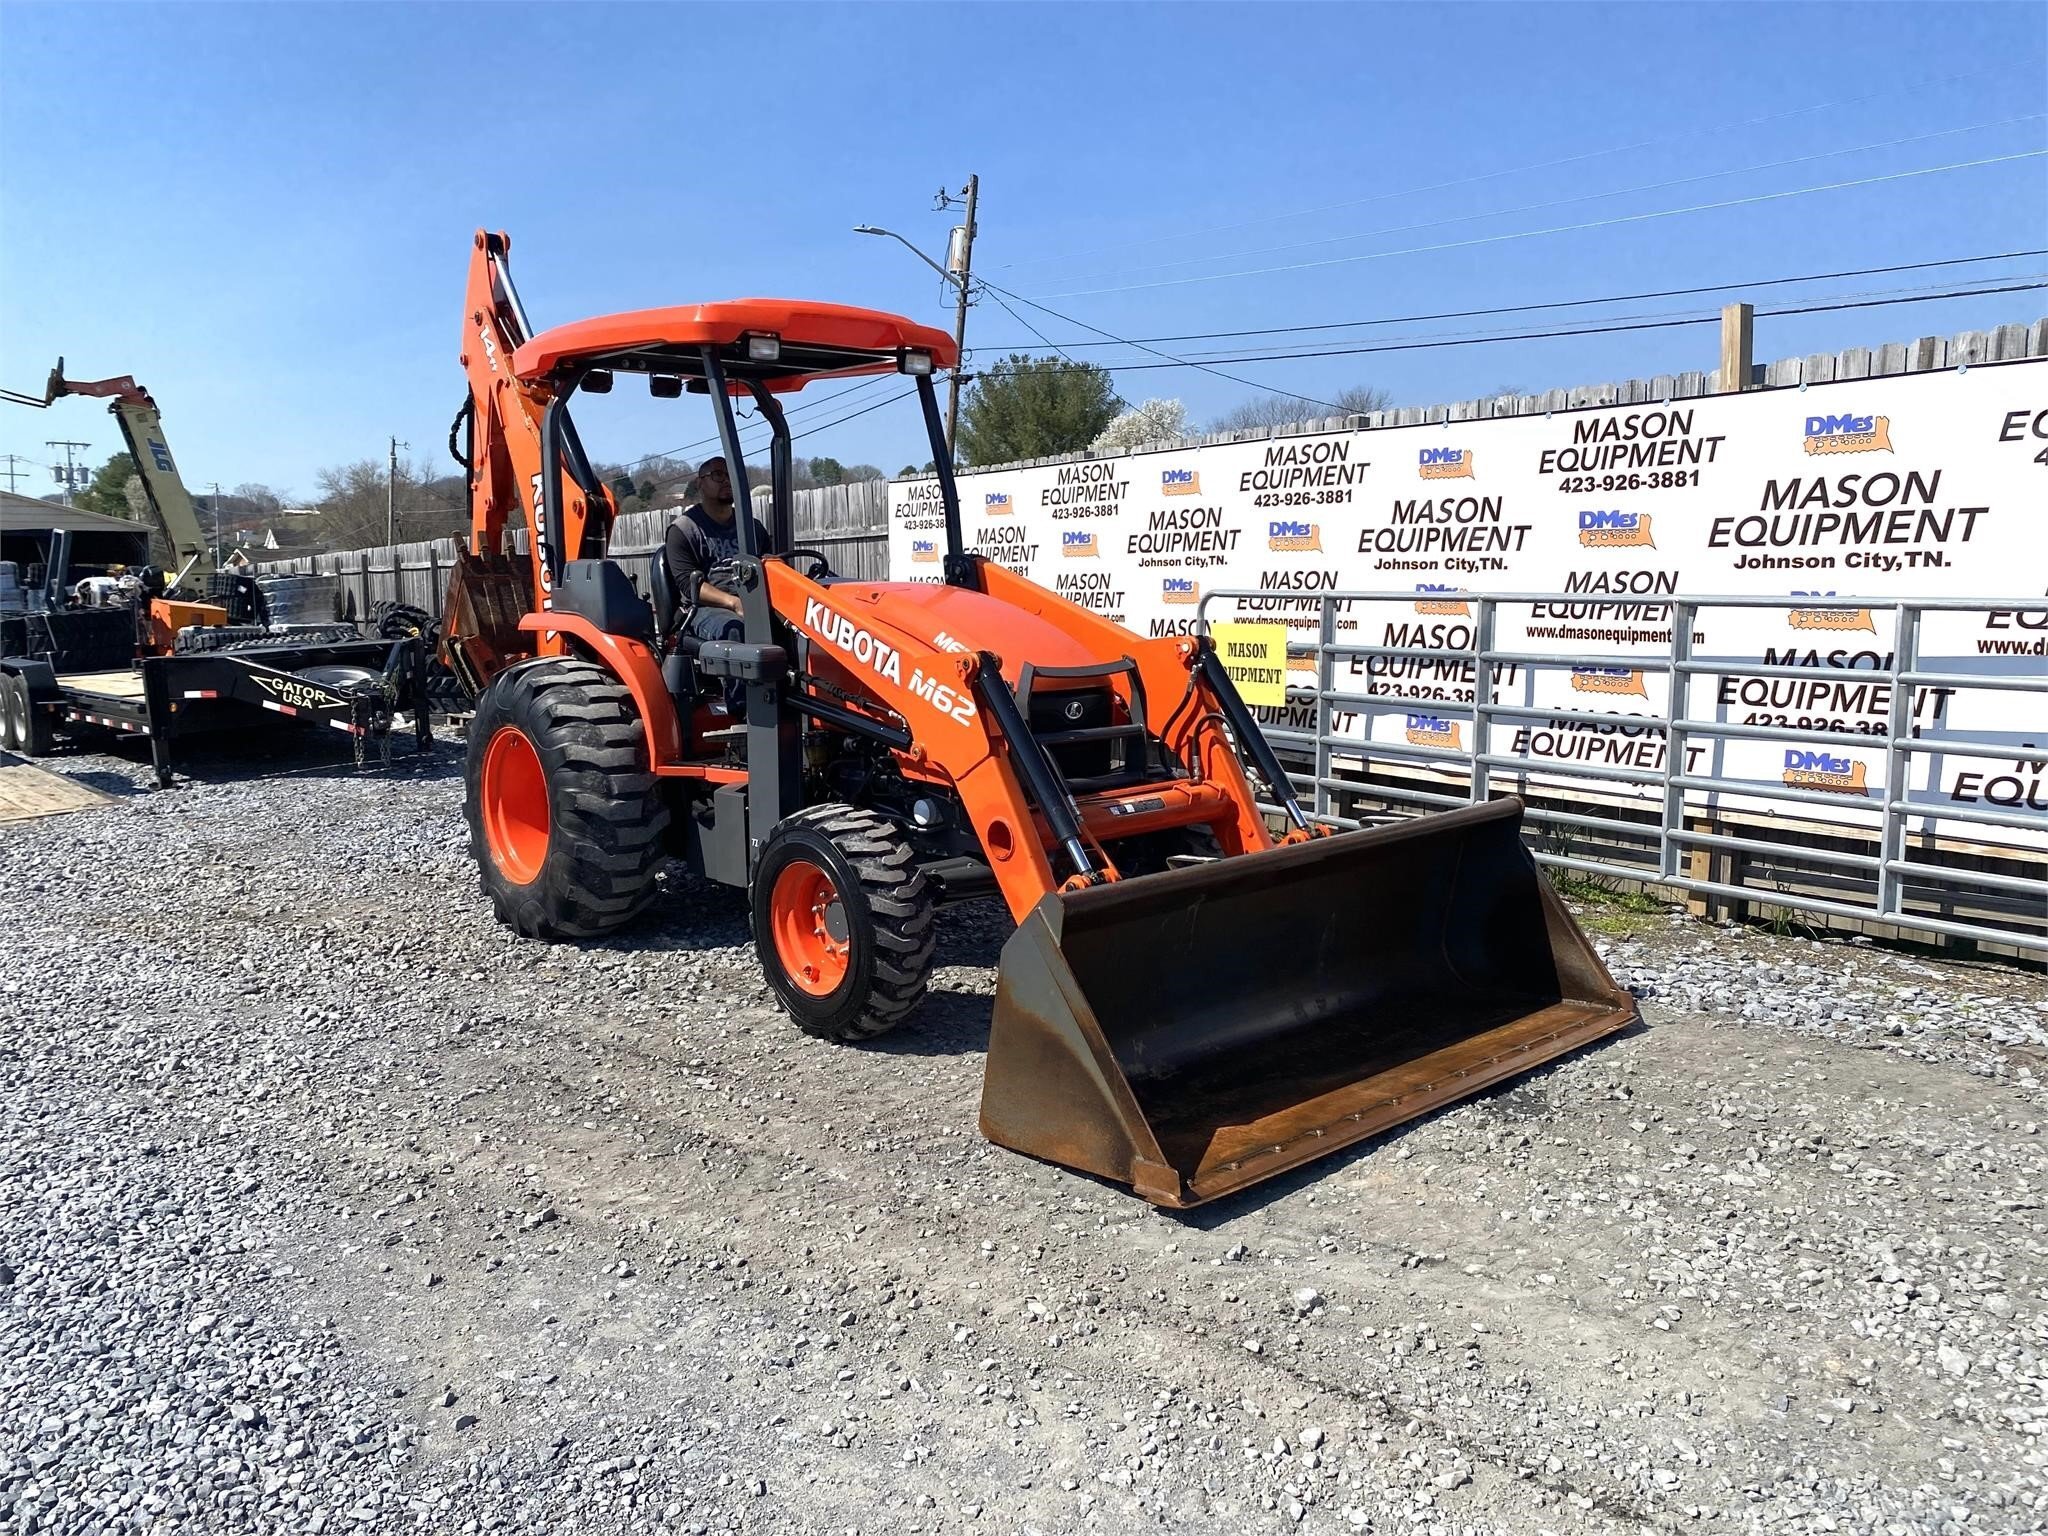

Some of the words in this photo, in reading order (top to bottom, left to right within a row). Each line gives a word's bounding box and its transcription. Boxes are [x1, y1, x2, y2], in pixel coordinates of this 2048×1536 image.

[1573, 409, 1694, 444] MASON
[1805, 413, 1874, 436] DMes
[147, 437, 174, 472] JLG
[1264, 440, 1350, 467] MASON
[1419, 447, 1462, 464] DMes
[1539, 436, 1726, 474] EQUIPMENT
[1058, 462, 1115, 486] MASON
[1239, 462, 1371, 492] EQUIPMENT
[1559, 469, 1699, 493] 423-926-3881
[908, 484, 944, 501] MASO
[1041, 480, 1130, 506] EQUIPMENT
[1254, 489, 1352, 507] 423-926-3881
[1760, 469, 1942, 511] MASON
[895, 501, 945, 518] EQUIPME
[1052, 503, 1119, 520] 423-926-3881
[1148, 506, 1223, 531] MASON
[1391, 496, 1502, 525] MASON
[1579, 510, 1638, 529] DMes
[904, 519, 947, 530] 423-926-38
[977, 525, 1026, 545] MASON
[1708, 506, 1990, 548] EQUIPMENT
[1127, 529, 1242, 554] EQUIPMENT
[1357, 525, 1532, 553] EQUIPMENT
[1138, 558, 1182, 568] Johnson
[1374, 559, 1439, 570] Johnson
[1733, 554, 1835, 569] Johnson
[1845, 551, 1951, 571] City,TN.
[1056, 572, 1111, 590] MASON
[1260, 571, 1338, 590] MASON
[1564, 570, 1679, 594] MASON
[1054, 591, 1125, 608] IPMENT
[1233, 615, 1358, 631] www.dmasonequipm.com
[1531, 603, 1697, 622] EQUIPMEN
[805, 596, 901, 687] KUBOTA
[932, 631, 971, 653] M6
[1383, 623, 1477, 651] MASO
[1527, 625, 1705, 645] www.dmasonequipmentm
[1228, 642, 1267, 659] MASON
[1763, 647, 1894, 671] MASO
[1224, 666, 1282, 684] UIPMENT
[272, 678, 326, 703] GATOR
[283, 692, 313, 709] USA
[908, 668, 977, 727] M62
[1368, 682, 1499, 705] 423-926-381
[1406, 713, 1450, 732] DMes
[1743, 713, 1920, 738] 423-926-381
[1784, 749, 1850, 773] DMes
